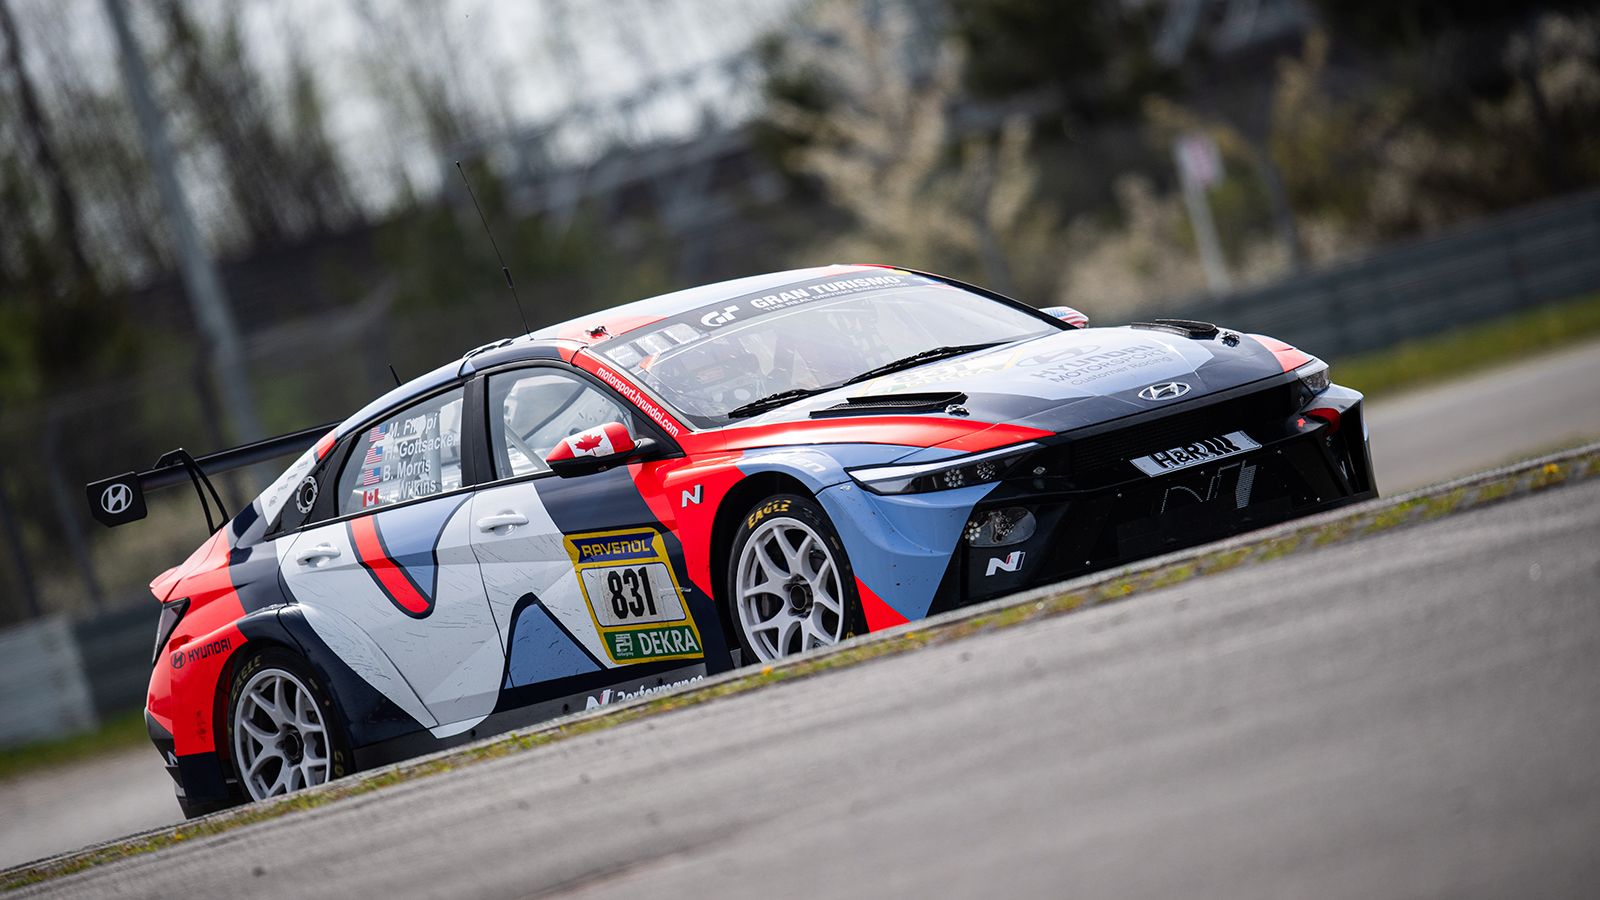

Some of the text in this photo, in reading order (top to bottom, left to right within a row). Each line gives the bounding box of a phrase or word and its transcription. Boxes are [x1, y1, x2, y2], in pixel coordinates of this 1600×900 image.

[750, 276, 900, 309] GRAN TURISMO
[763, 303, 786, 312] THE
[1030, 345, 1155, 378] HYUNDAI
[1050, 349, 1167, 384] MOTORSPORT
[1070, 356, 1174, 386] Customer Racing
[596, 367, 679, 437] motorsport.hyundai.com
[387, 421, 400, 438] M.
[383, 457, 431, 482] B. Morris
[747, 499, 793, 530] EAGLE
[985, 550, 1026, 576] N
[607, 566, 658, 620] 831
[188, 638, 232, 663] HYUNDAI
[637, 628, 699, 655] DEKRA
